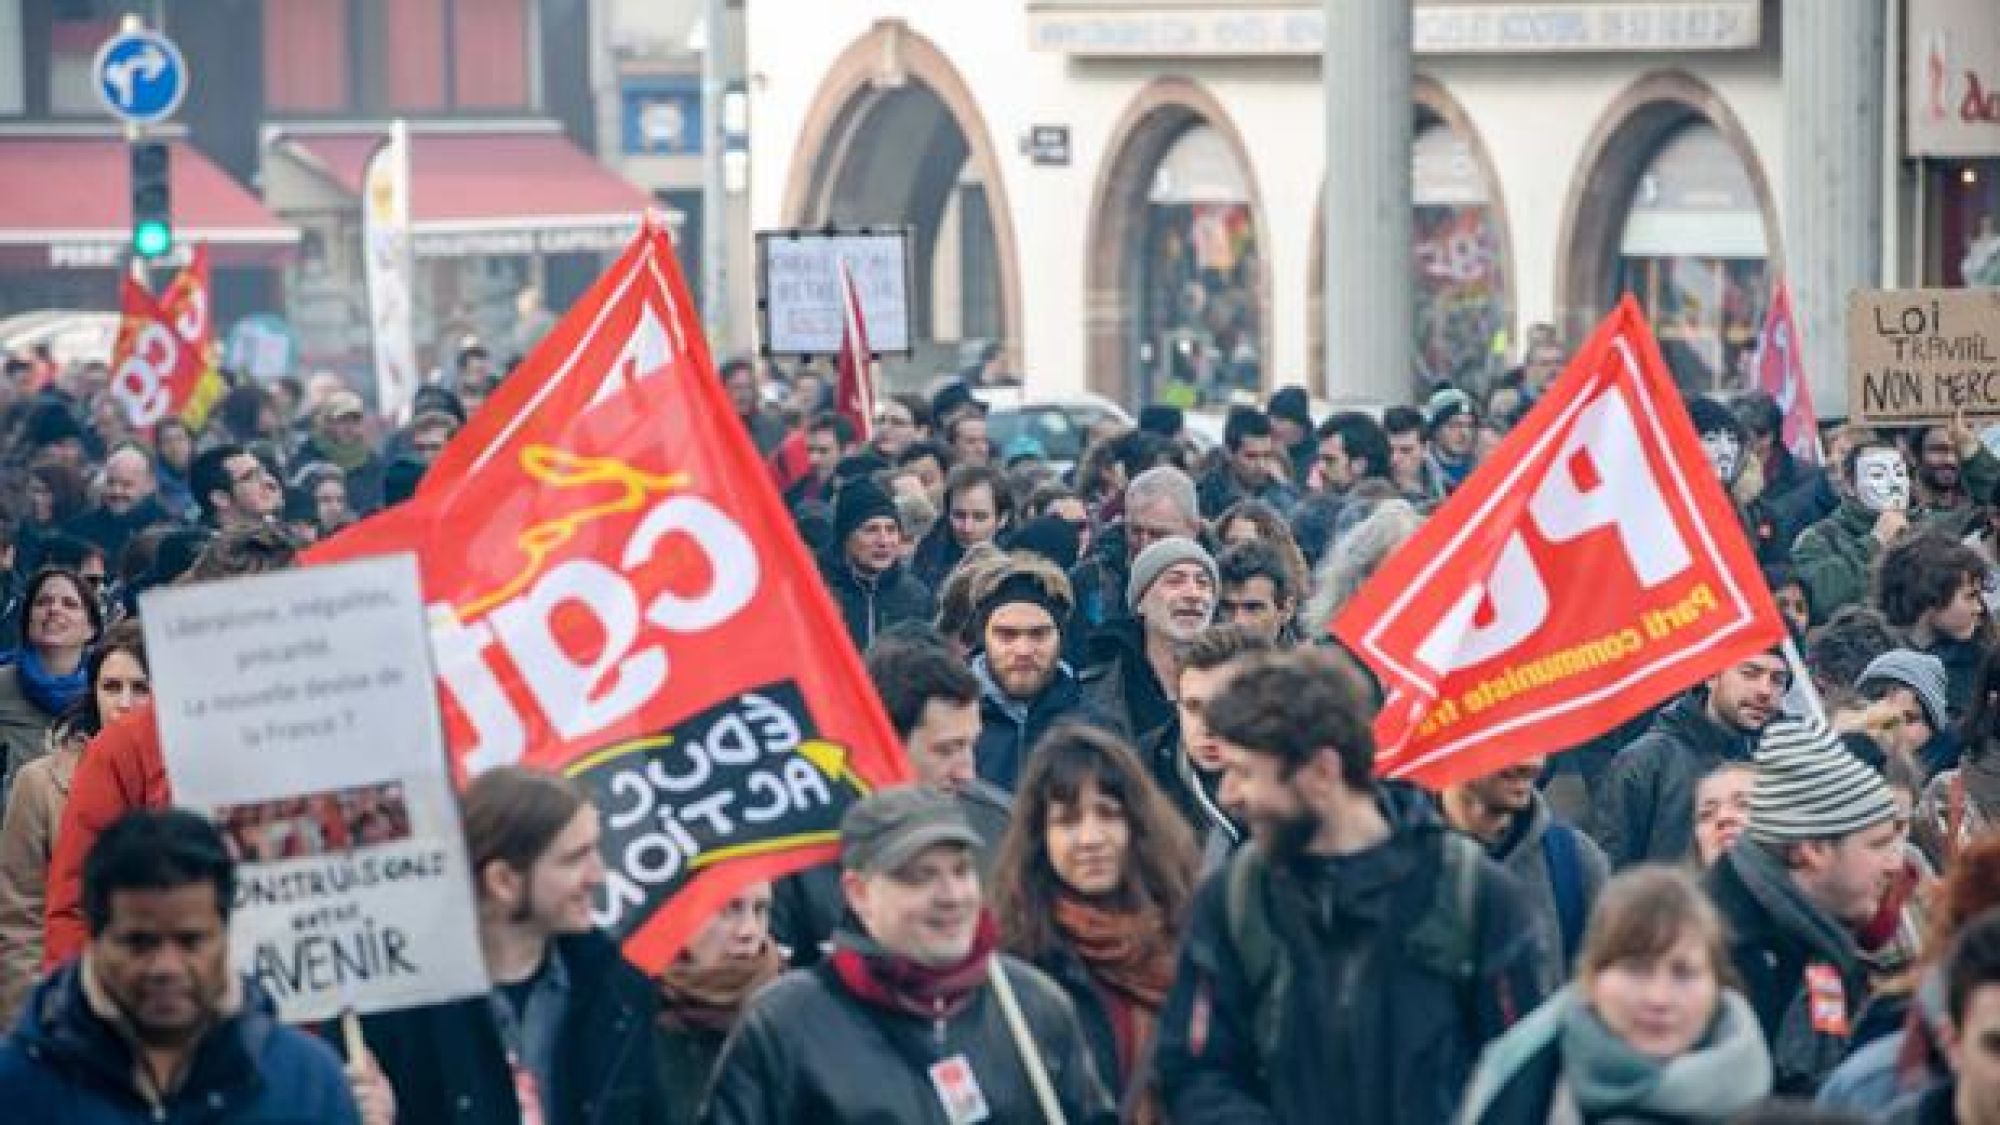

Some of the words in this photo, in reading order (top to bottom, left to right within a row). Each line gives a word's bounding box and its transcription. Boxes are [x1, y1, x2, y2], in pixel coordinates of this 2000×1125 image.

[1863, 367, 1923, 412] NON
[1934, 369, 2000, 407] MERC
[232, 852, 442, 910] ONSTRUISONS
